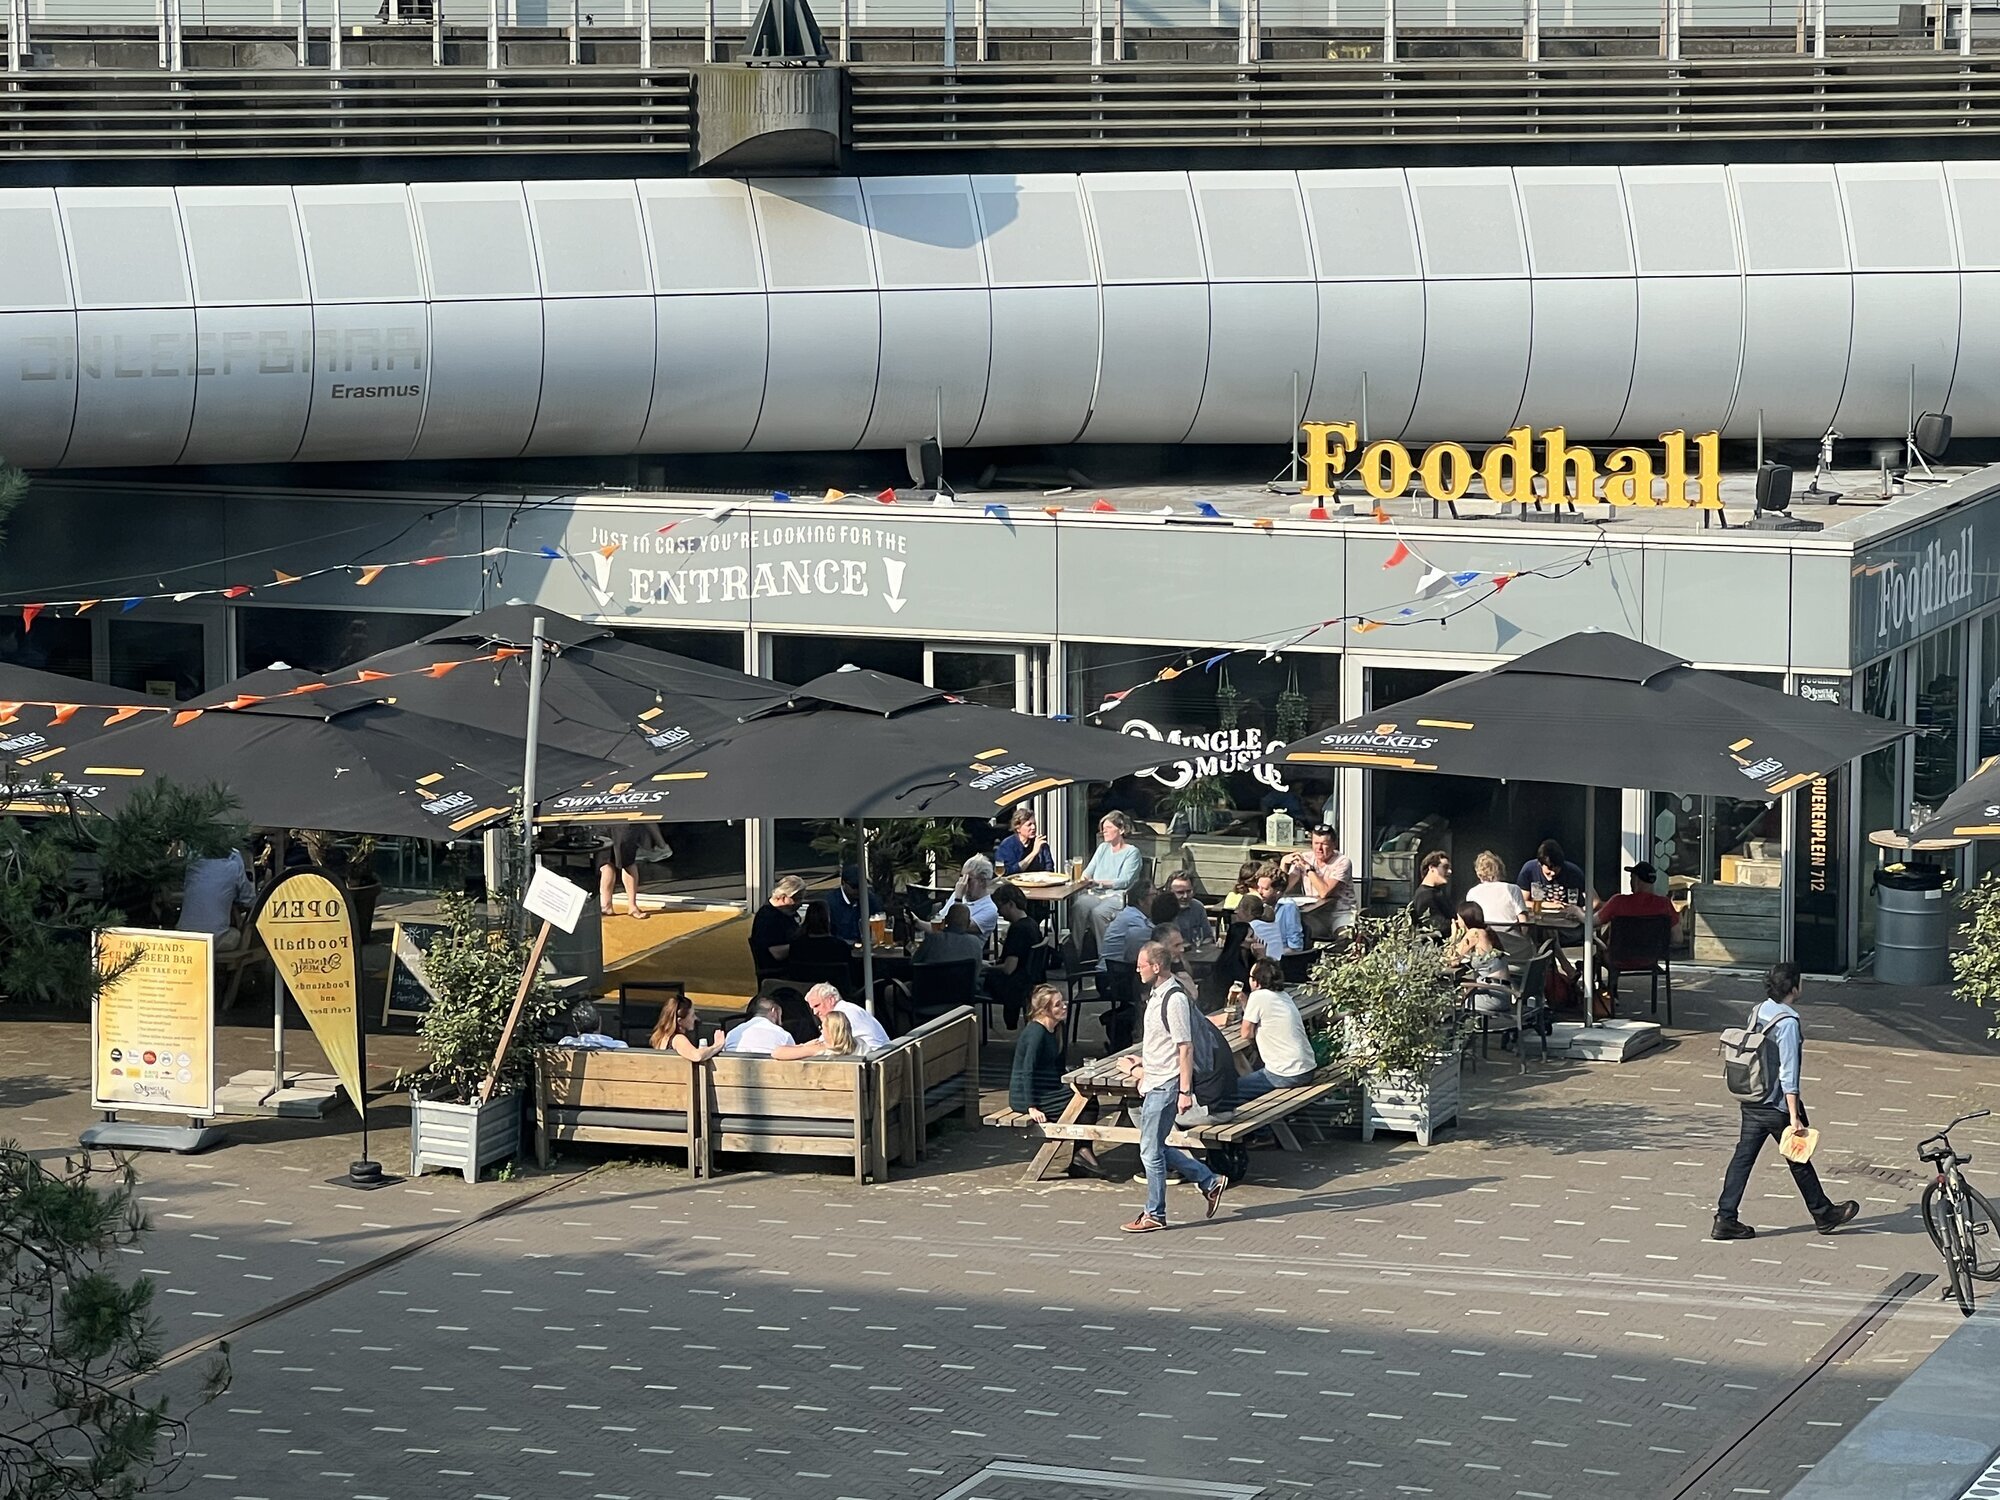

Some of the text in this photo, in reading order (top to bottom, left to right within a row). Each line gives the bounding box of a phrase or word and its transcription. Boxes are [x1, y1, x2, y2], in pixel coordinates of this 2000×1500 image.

[331, 384, 420, 399] Erasmus
[1300, 420, 1726, 510] Foodhall
[591, 527, 628, 550] JUST
[655, 537, 695, 554] CASE
[700, 531, 759, 553] YOU'RE
[763, 525, 836, 546] LOOKING
[840, 526, 872, 546] FOR
[875, 530, 907, 554] THE
[628, 559, 869, 605] ENTRANCE
[1878, 524, 1974, 637] Foodhall
[1320, 734, 1438, 749] SWINCKELS'
[1810, 870, 1825, 891] 712
